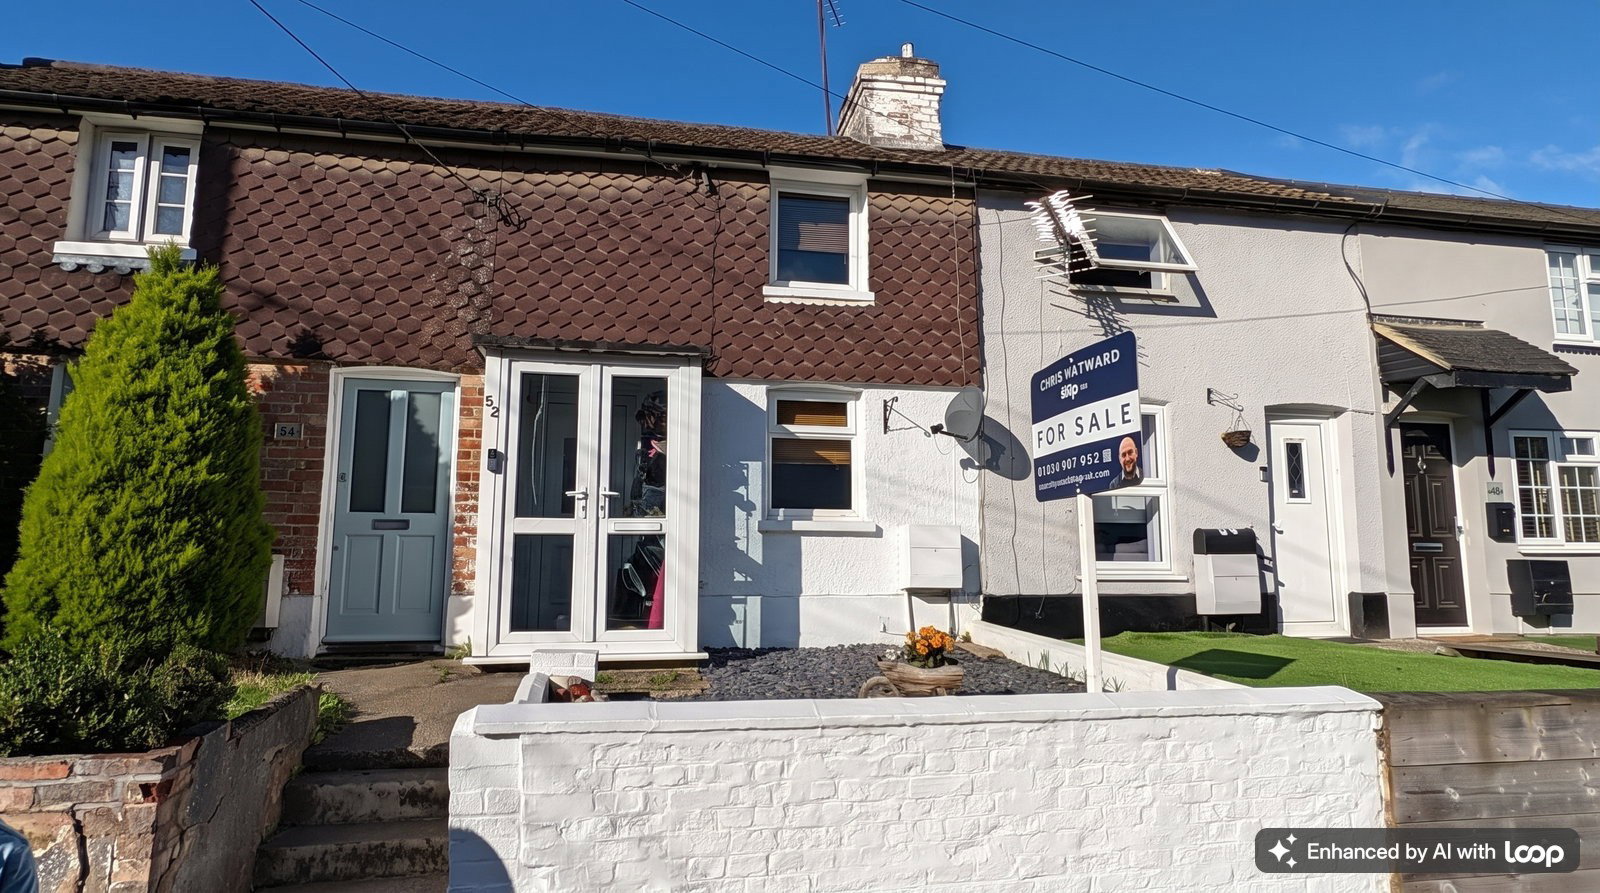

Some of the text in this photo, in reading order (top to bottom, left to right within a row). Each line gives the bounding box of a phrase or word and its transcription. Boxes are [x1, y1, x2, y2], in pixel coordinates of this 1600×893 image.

[1040, 349, 1120, 392] CHRIS WATWARD
[485, 395, 500, 418] 52
[280, 426, 295, 437] 54
[1037, 402, 1132, 449] FOR SALE
[1061, 457, 1077, 471] 907
[1080, 452, 1100, 467] 952
